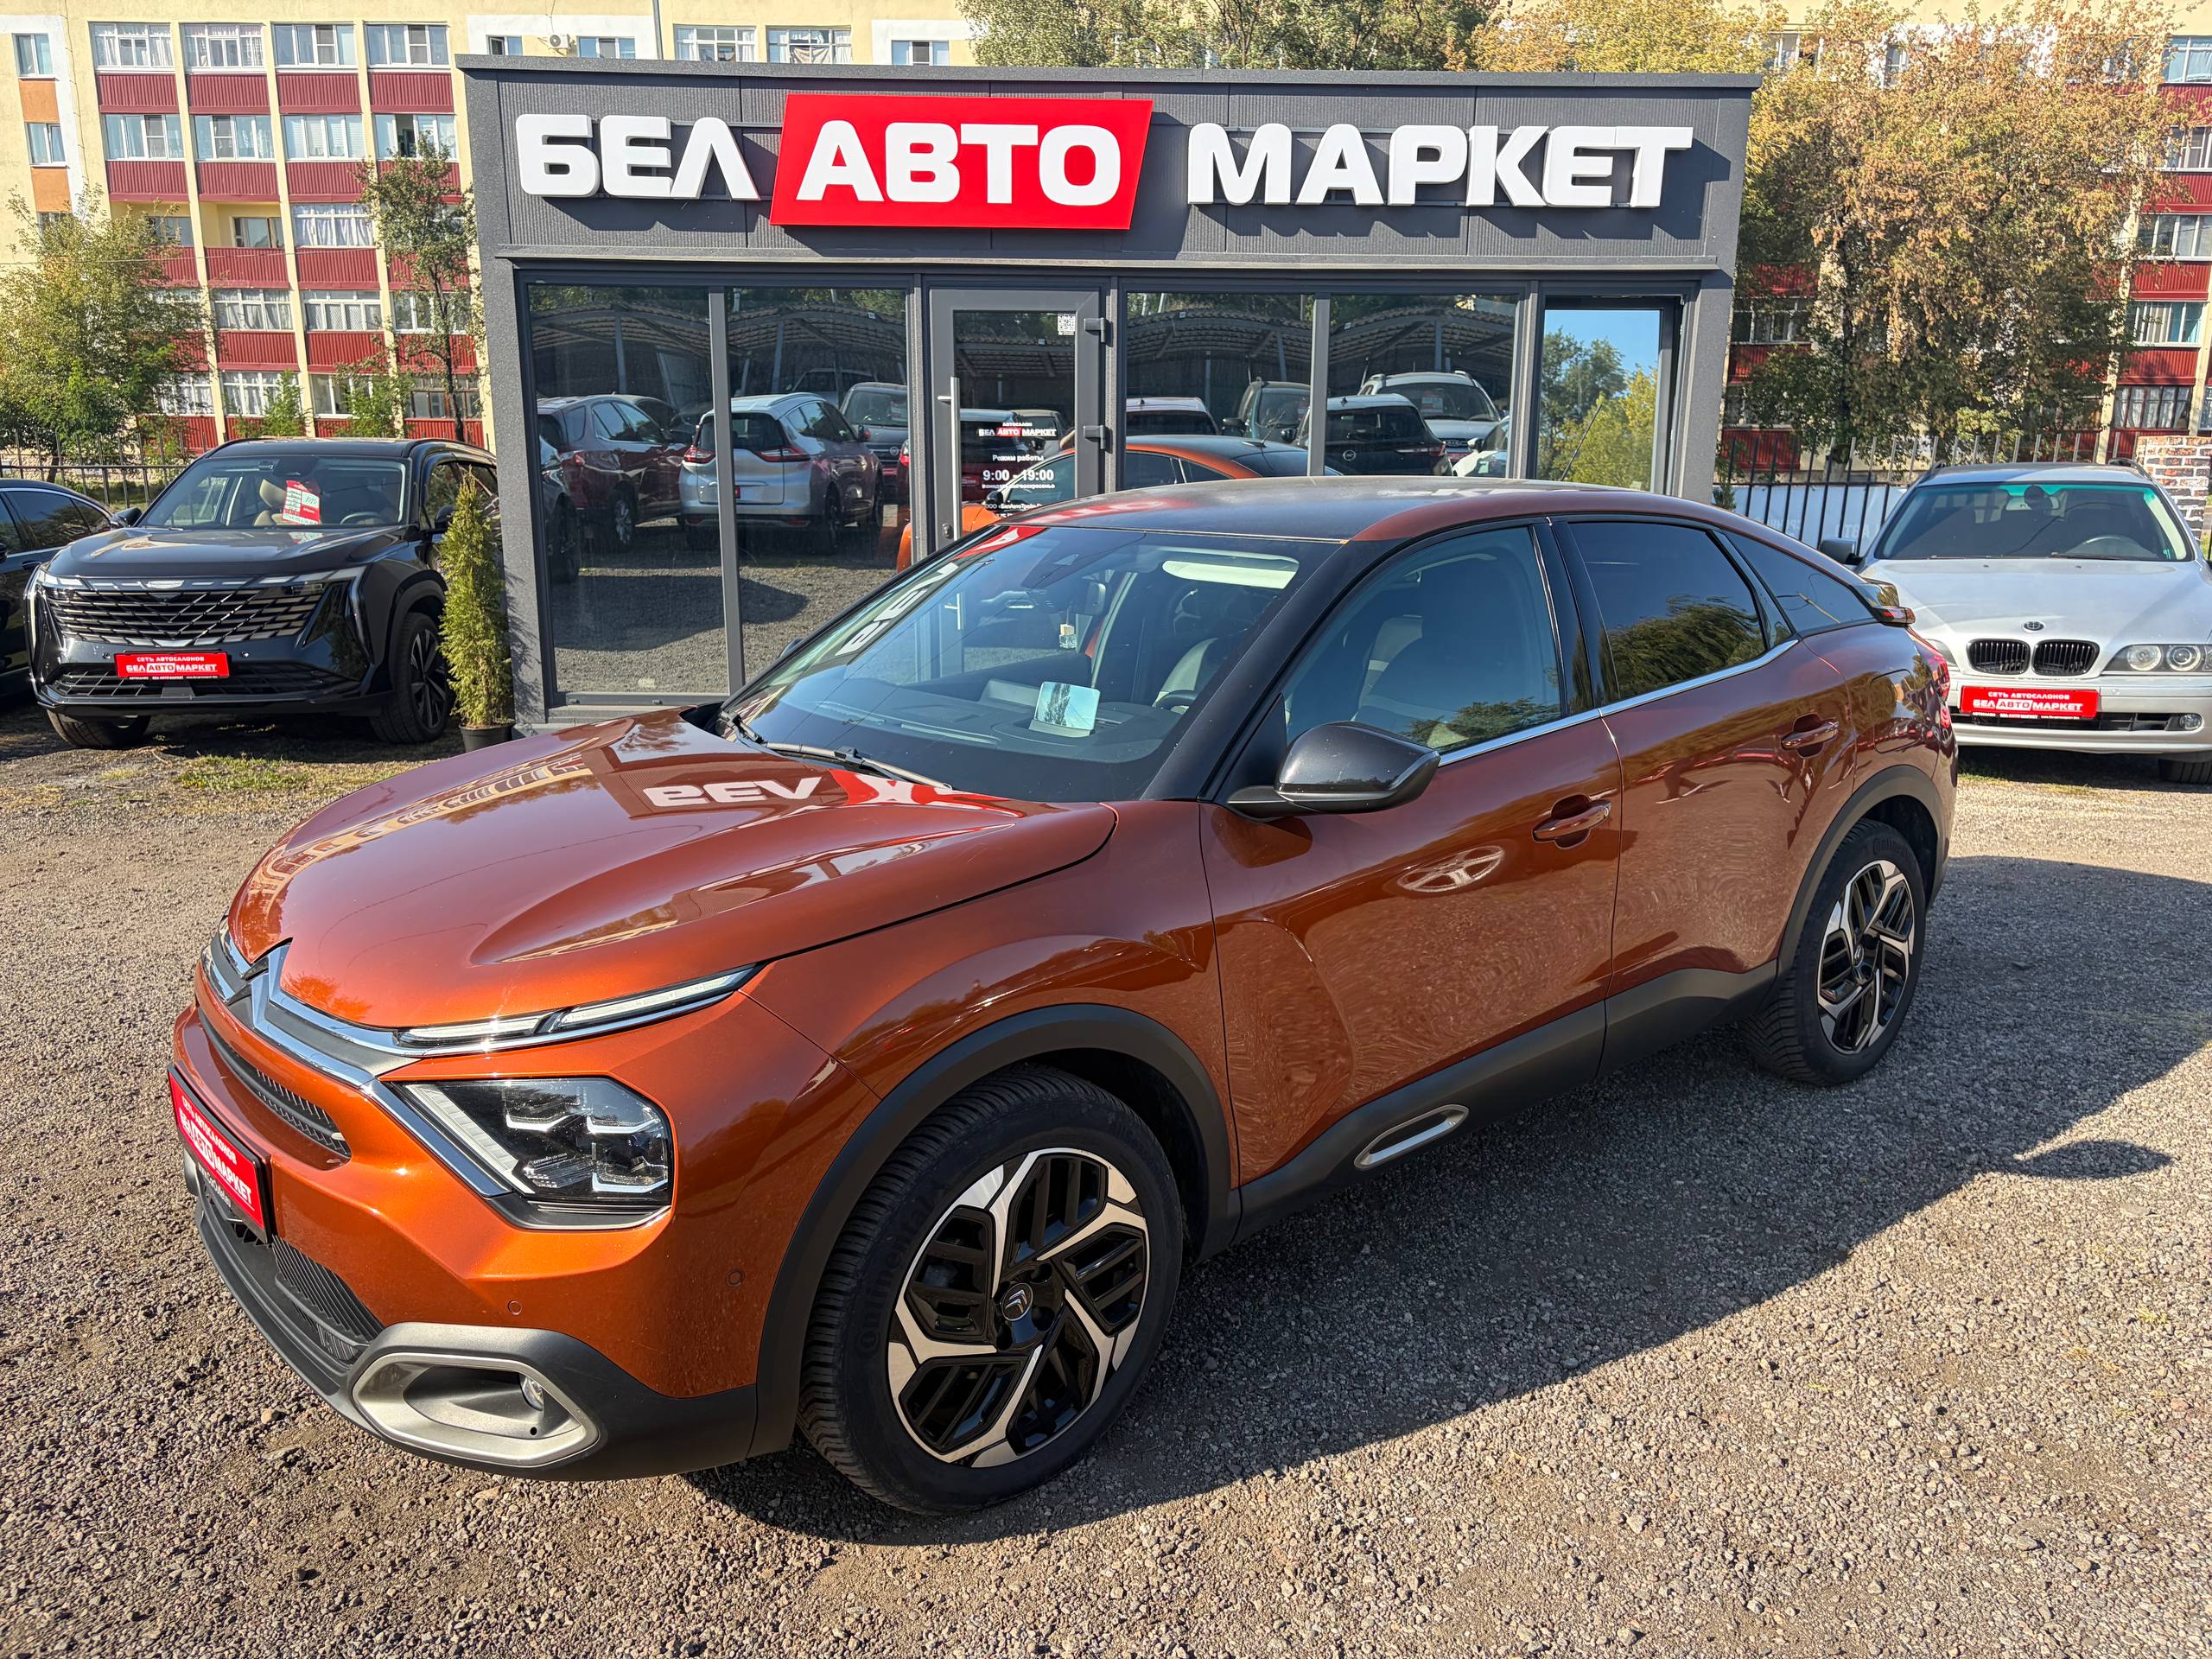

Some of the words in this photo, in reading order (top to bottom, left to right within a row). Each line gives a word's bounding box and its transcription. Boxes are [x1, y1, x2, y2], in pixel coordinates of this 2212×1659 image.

[516, 114, 760, 200] БЕЛ
[796, 120, 1121, 206] АВТО
[1187, 122, 1694, 207] МАРКЕТ
[1021, 429, 1057, 437] МАРКЕТ
[982, 469, 1010, 480] 9:00
[1022, 469, 1054, 480] 19:00
[1973, 700, 1995, 709] БЕЛ
[1999, 701, 2031, 709] АВТО
[2032, 702, 2083, 711] МАРКЕТ
[213, 1154, 253, 1205] МАРКЕТ
